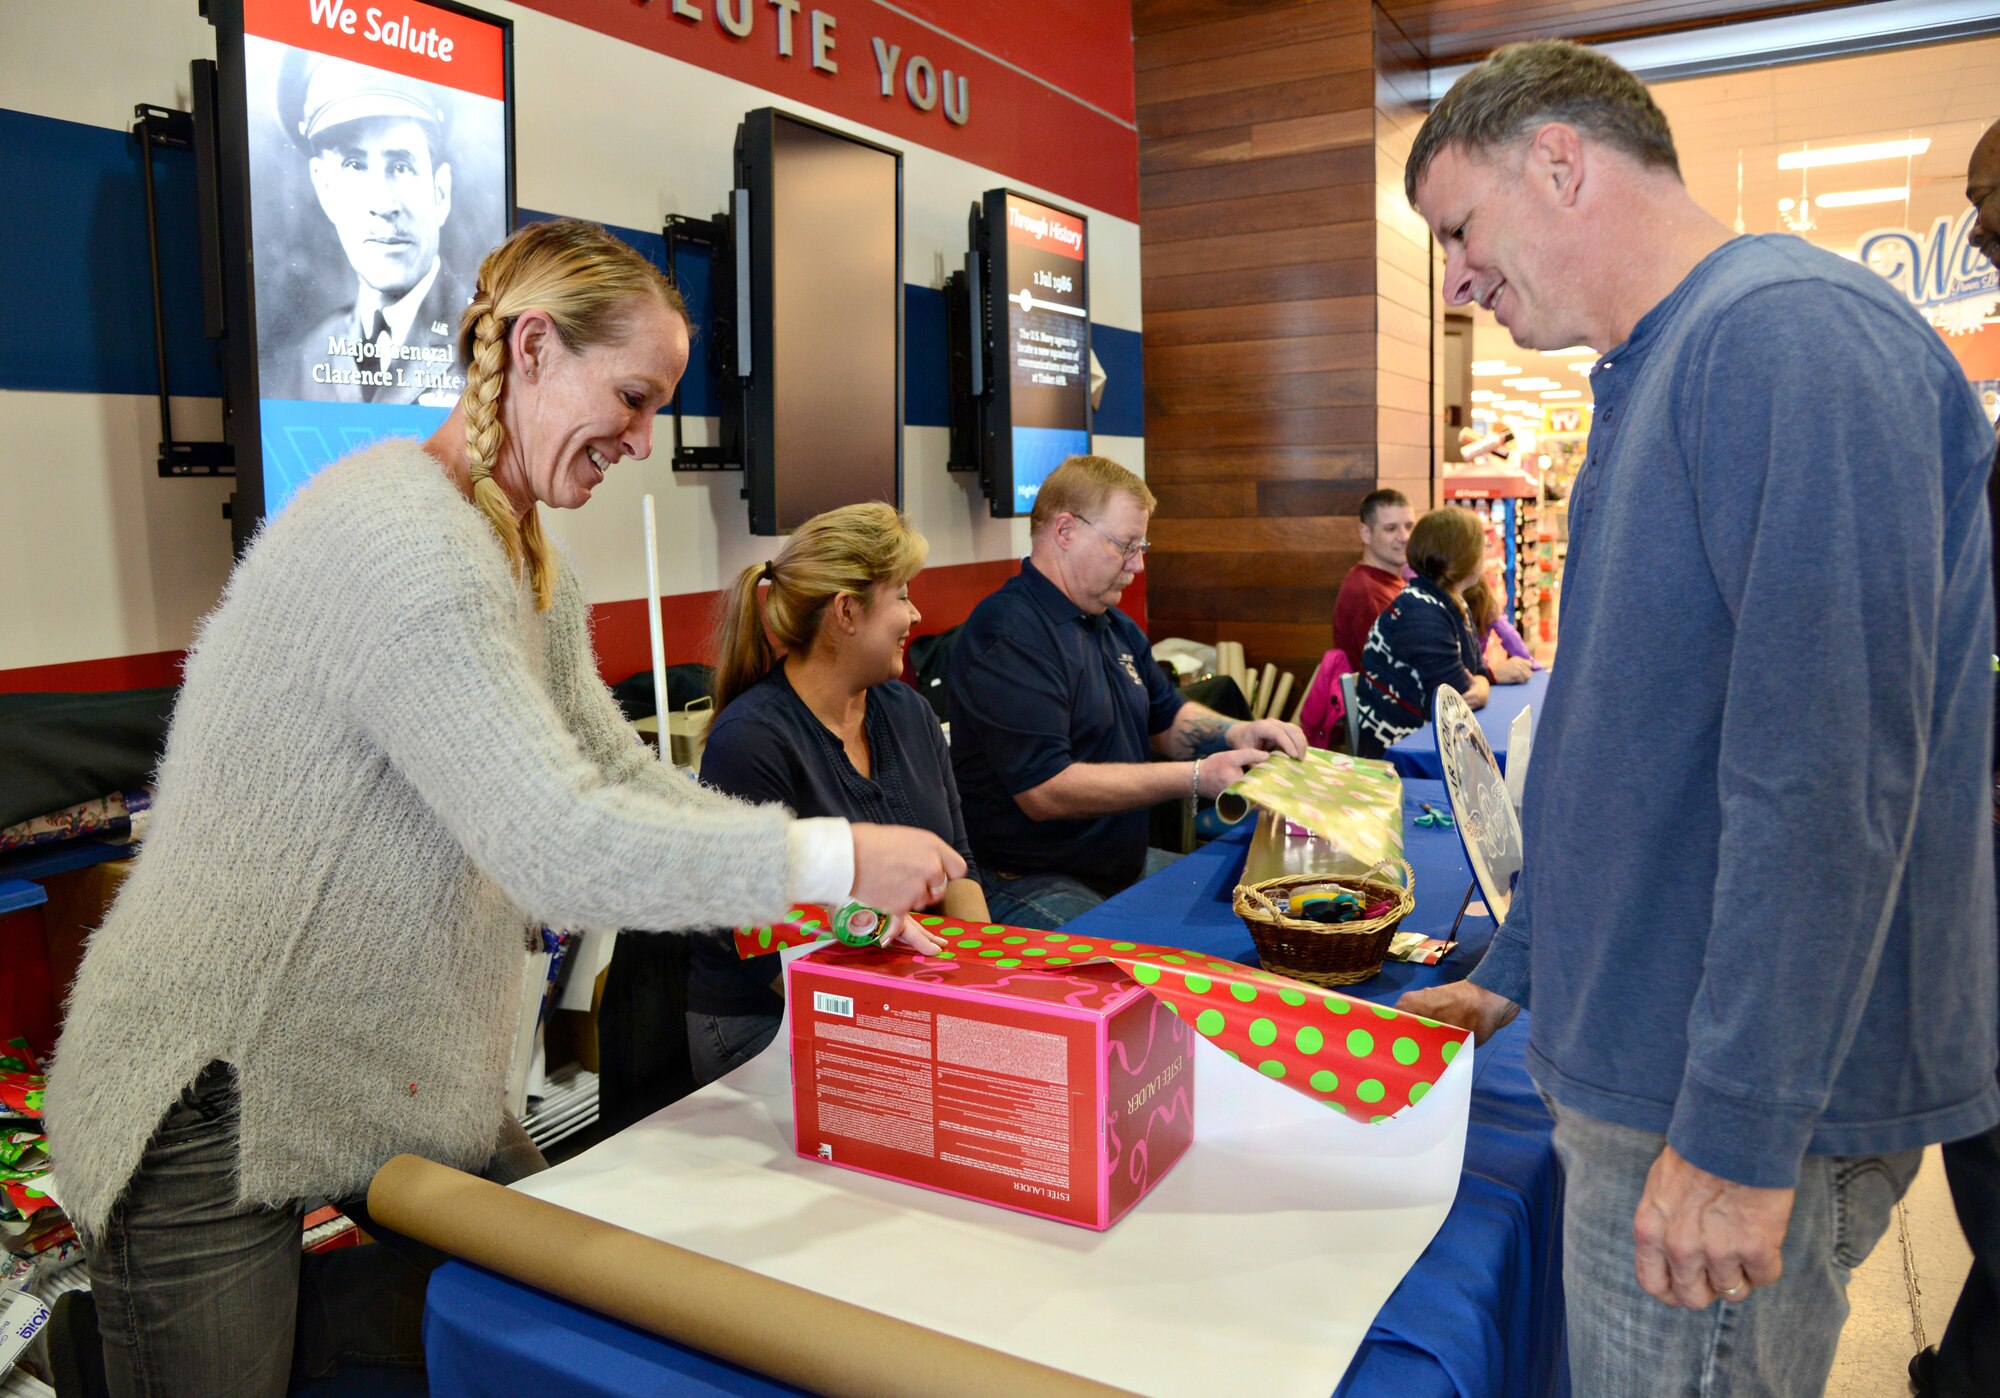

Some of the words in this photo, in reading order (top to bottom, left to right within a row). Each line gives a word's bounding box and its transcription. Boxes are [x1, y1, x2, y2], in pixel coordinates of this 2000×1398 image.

[309, 0, 357, 34] We
[363, 7, 454, 62] Salute
[872, 36, 970, 126] YOU
[1008, 206, 1048, 239] Through
[1049, 220, 1082, 251] History
[327, 335, 382, 363] Major
[312, 362, 393, 386] Clarence
[396, 368, 411, 387] L.
[1550, 409, 1581, 432] TV
[1162, 1056, 1183, 1087] ESTÉE
[1127, 1075, 1161, 1115] LAUDER
[1013, 1181, 1045, 1197] LAUDER
